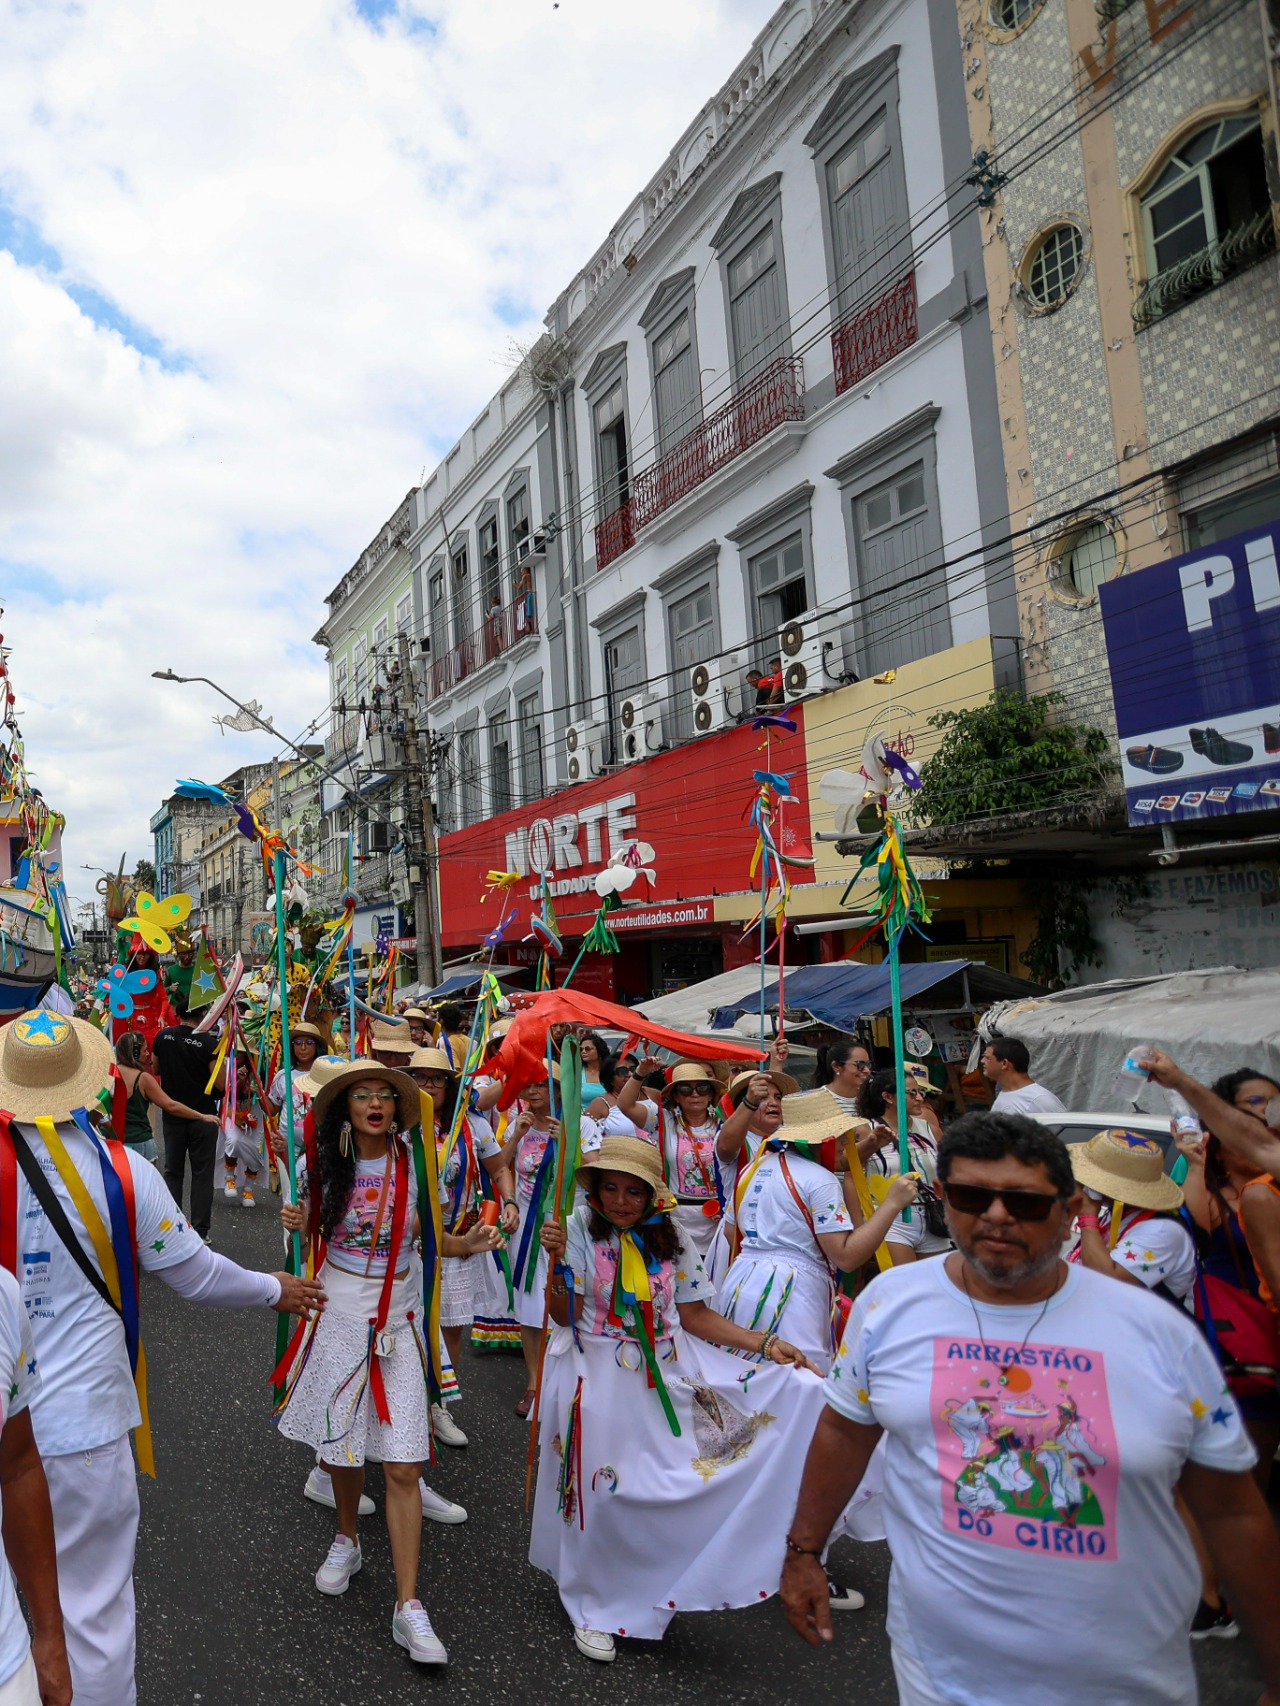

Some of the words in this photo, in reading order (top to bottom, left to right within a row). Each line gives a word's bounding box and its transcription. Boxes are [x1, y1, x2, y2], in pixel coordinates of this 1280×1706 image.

[1137, 800, 1152, 808] VISA
[505, 792, 639, 877] NORTE
[1184, 869, 1275, 896] FAZEMOS
[946, 1342, 1092, 1373] ARRASTÃO
[957, 1507, 993, 1536] DO
[1015, 1518, 1106, 1556] CÍRIO
